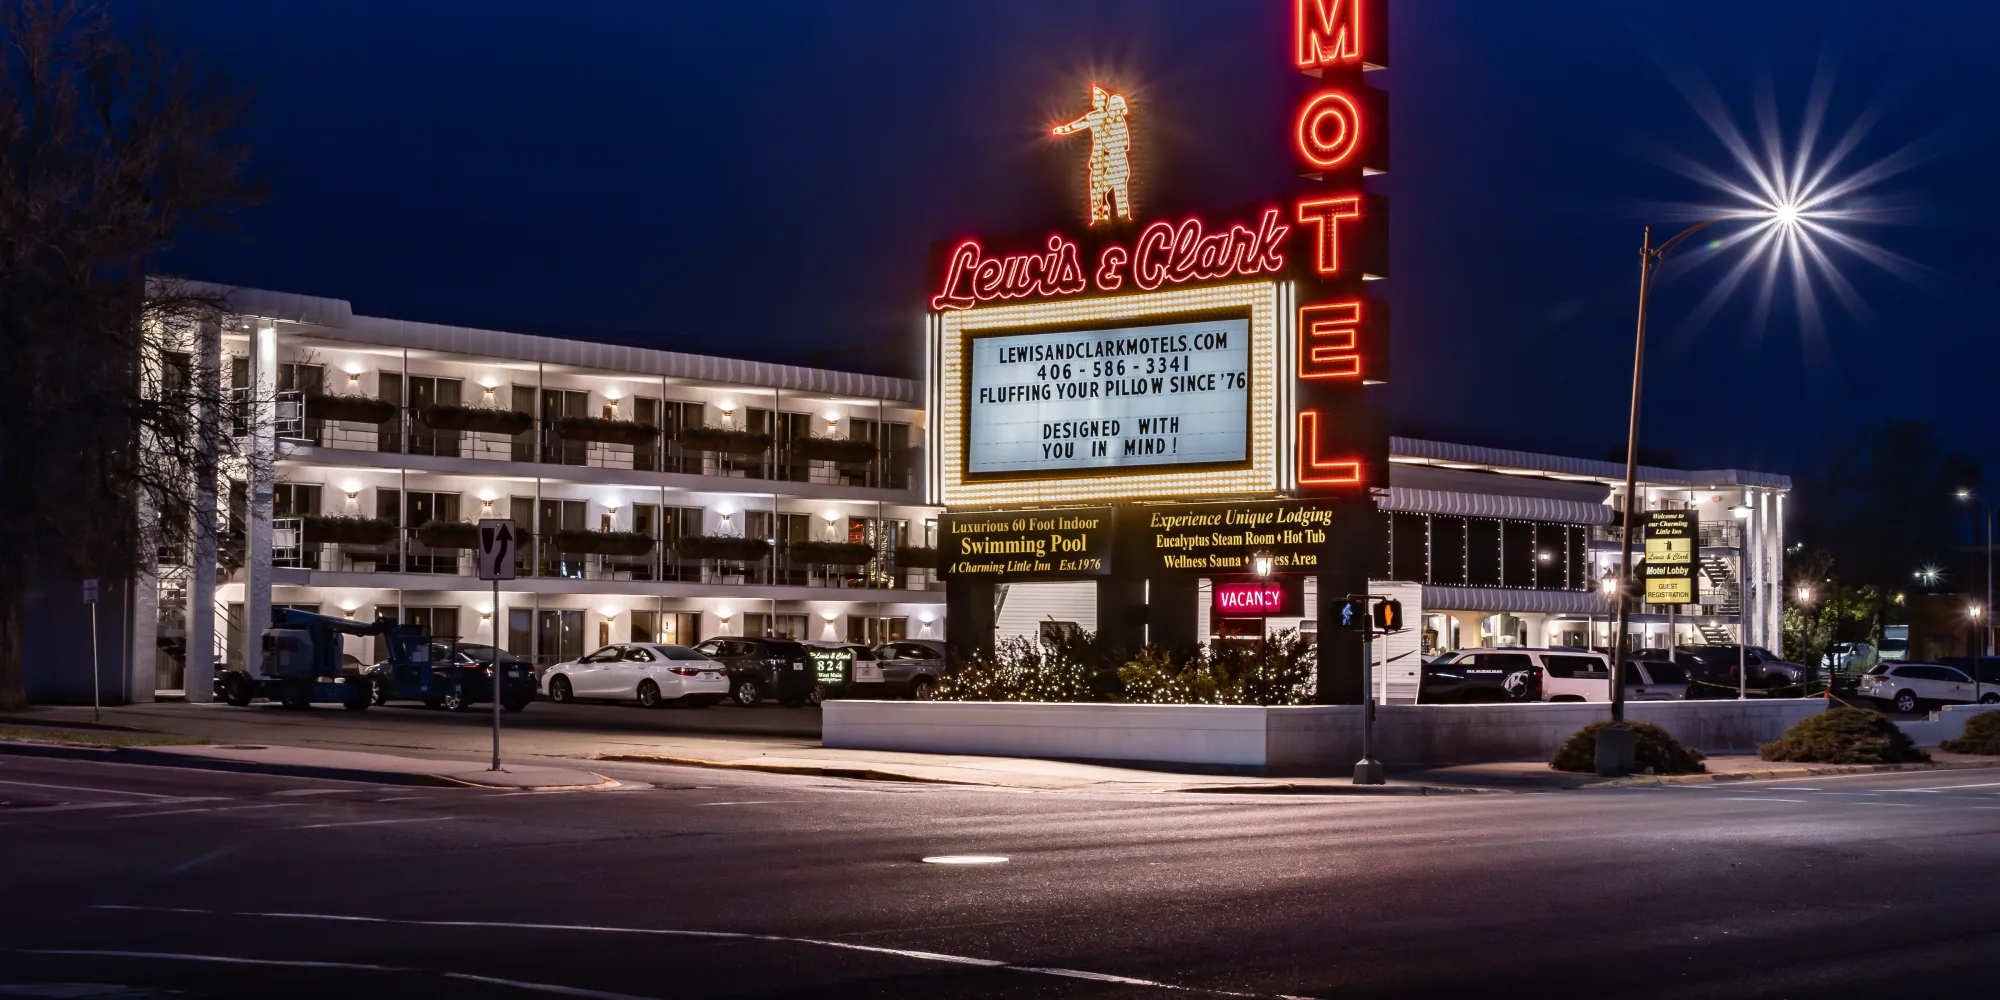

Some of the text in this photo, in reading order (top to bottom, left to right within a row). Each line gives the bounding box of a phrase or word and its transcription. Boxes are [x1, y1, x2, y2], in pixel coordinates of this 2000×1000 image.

[1298, 0, 1361, 484] MOTEL
[932, 209, 1291, 311] Lewis & Clark
[999, 332, 1228, 364] LEWISANDCLARKMOTELS.COM
[979, 371, 1246, 404] FLUFFING YOUR PILLOW SINCE '76
[1043, 416, 1179, 440] DESIGNED WITH
[1043, 442, 1074, 460] YOU
[1091, 440, 1107, 457] IN
[951, 516, 1099, 534] Luxurious 60 Foot Indoor
[1150, 505, 1333, 532] Experience Unique Lodging
[961, 533, 1087, 558] Swimming Pool
[1156, 528, 1326, 551] Eucalyptus Steam Room Hot Tub
[1163, 554, 1208, 569] Wellness
[1209, 553, 1241, 567] Sauna
[1291, 551, 1317, 566] Area
[1672, 552, 1689, 561] Clark
[949, 562, 957, 573] A
[958, 561, 1005, 575] Charming
[1007, 559, 1032, 572] Little
[1033, 559, 1051, 571] Inn
[1646, 566, 1689, 576] Motel Lobby
[1221, 591, 1280, 607] VACANCY
[814, 652, 830, 660] Lewis
[836, 652, 851, 660] Clark
[817, 660, 843, 671] 824
